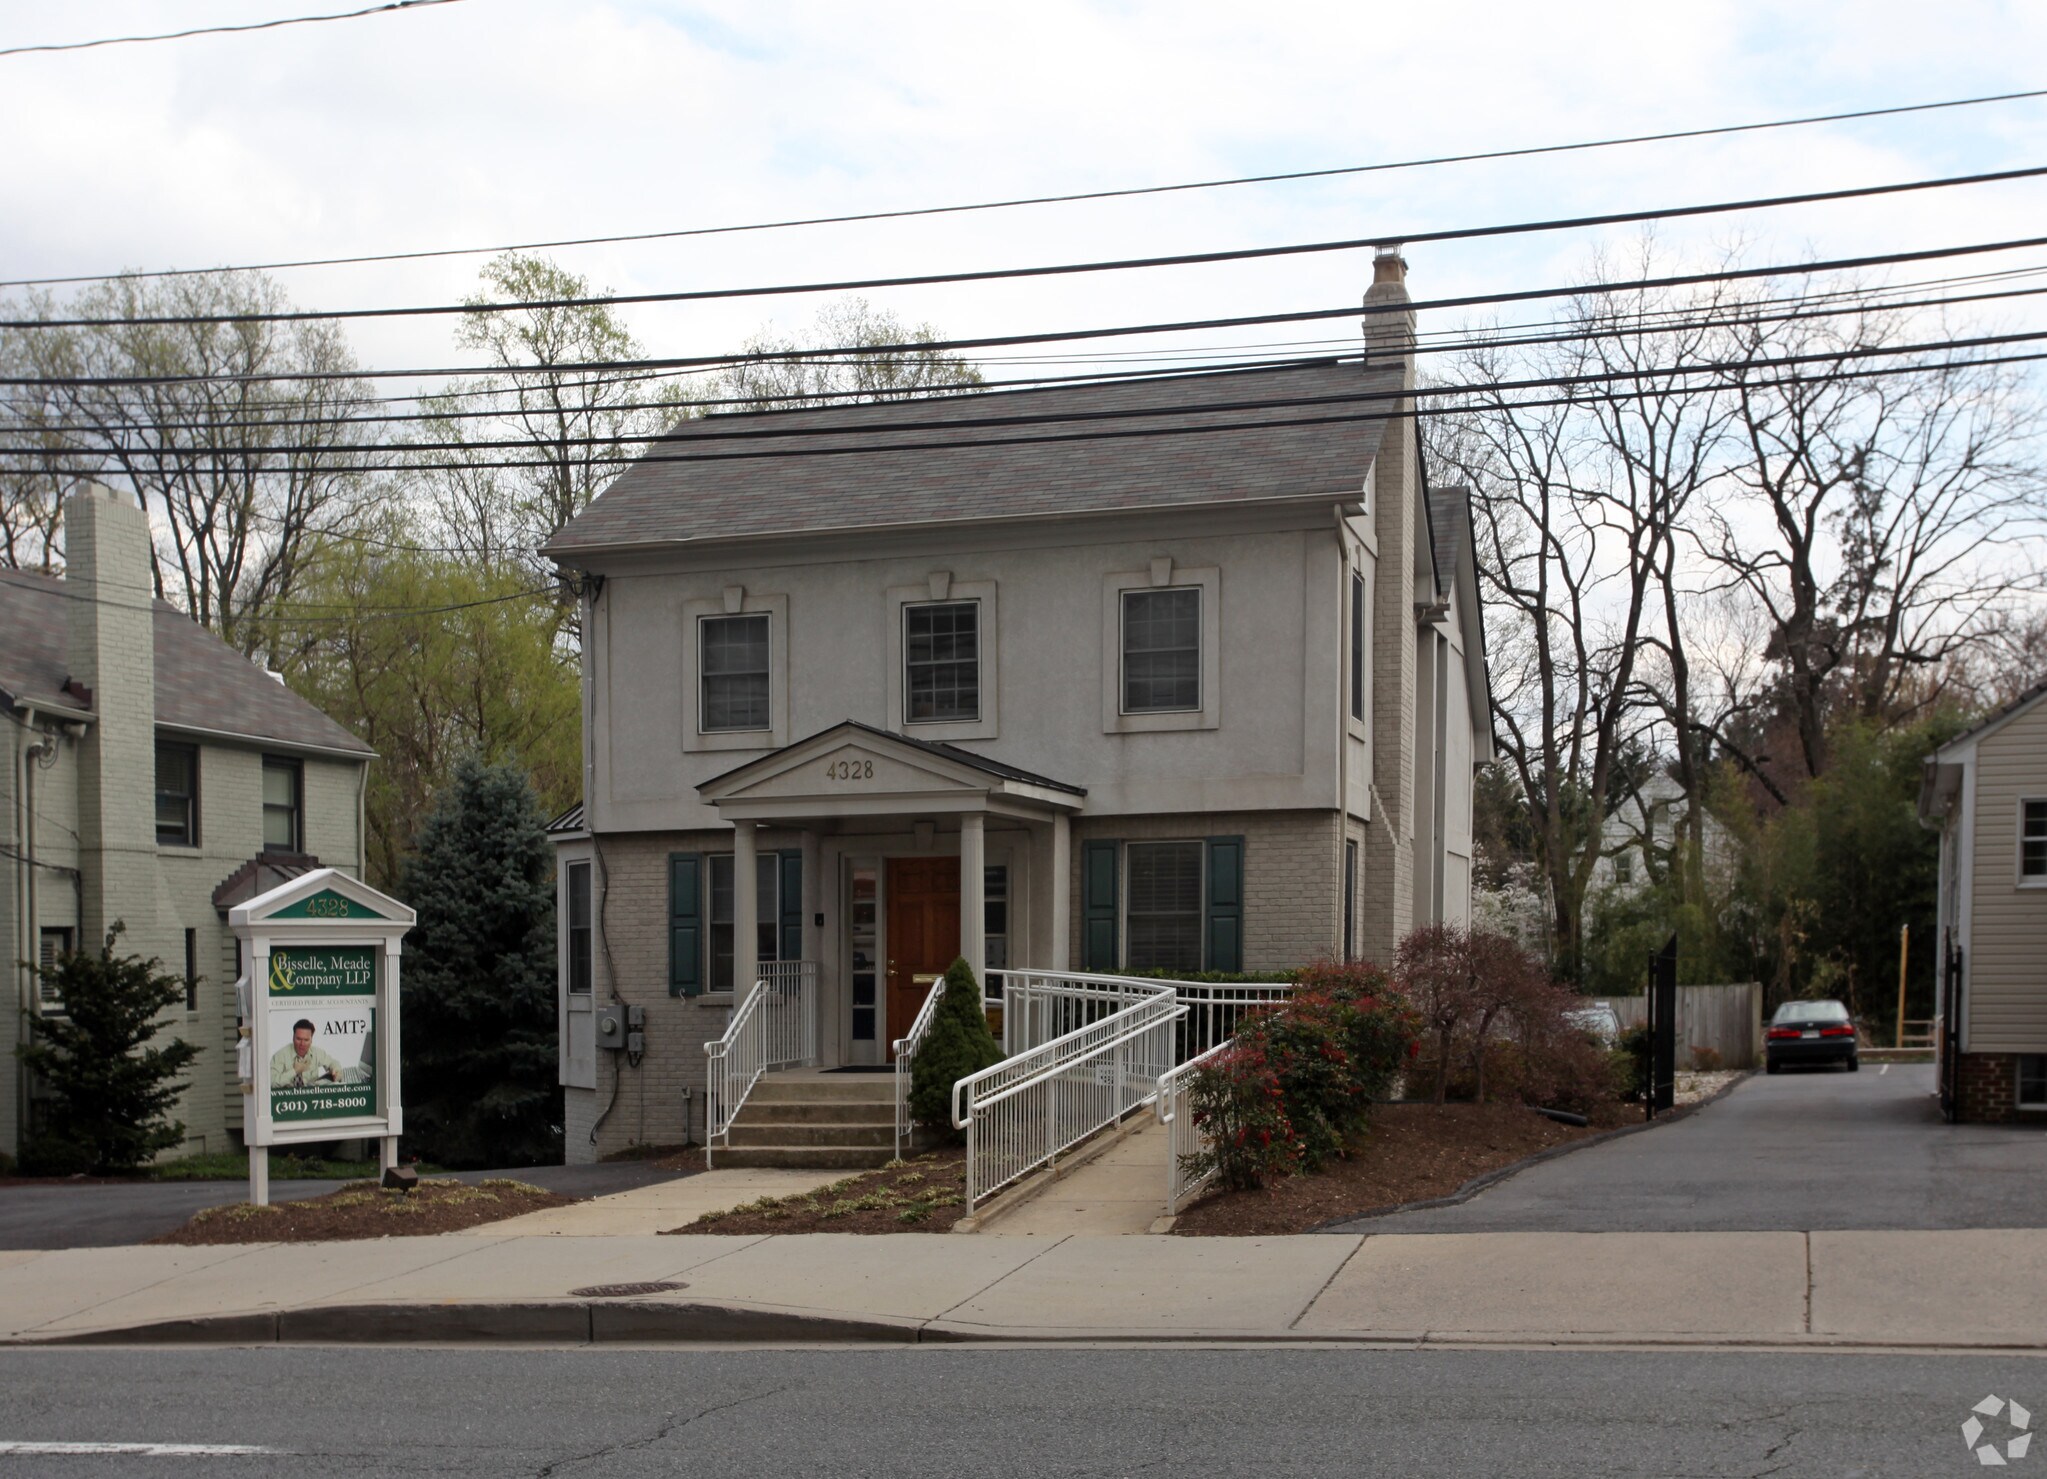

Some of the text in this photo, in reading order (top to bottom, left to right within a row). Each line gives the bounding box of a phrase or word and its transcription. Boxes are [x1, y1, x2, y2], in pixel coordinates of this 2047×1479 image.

[826, 760, 873, 780] 4328
[306, 898, 349, 917] 4328
[269, 951, 371, 991] & Company LLP
[278, 956, 371, 972] Bisselle, Meade
[323, 1020, 366, 1035] AMT?
[270, 1084, 371, 1097] www.bissellemeade.com
[275, 1097, 367, 1115] (301) 718-8000
